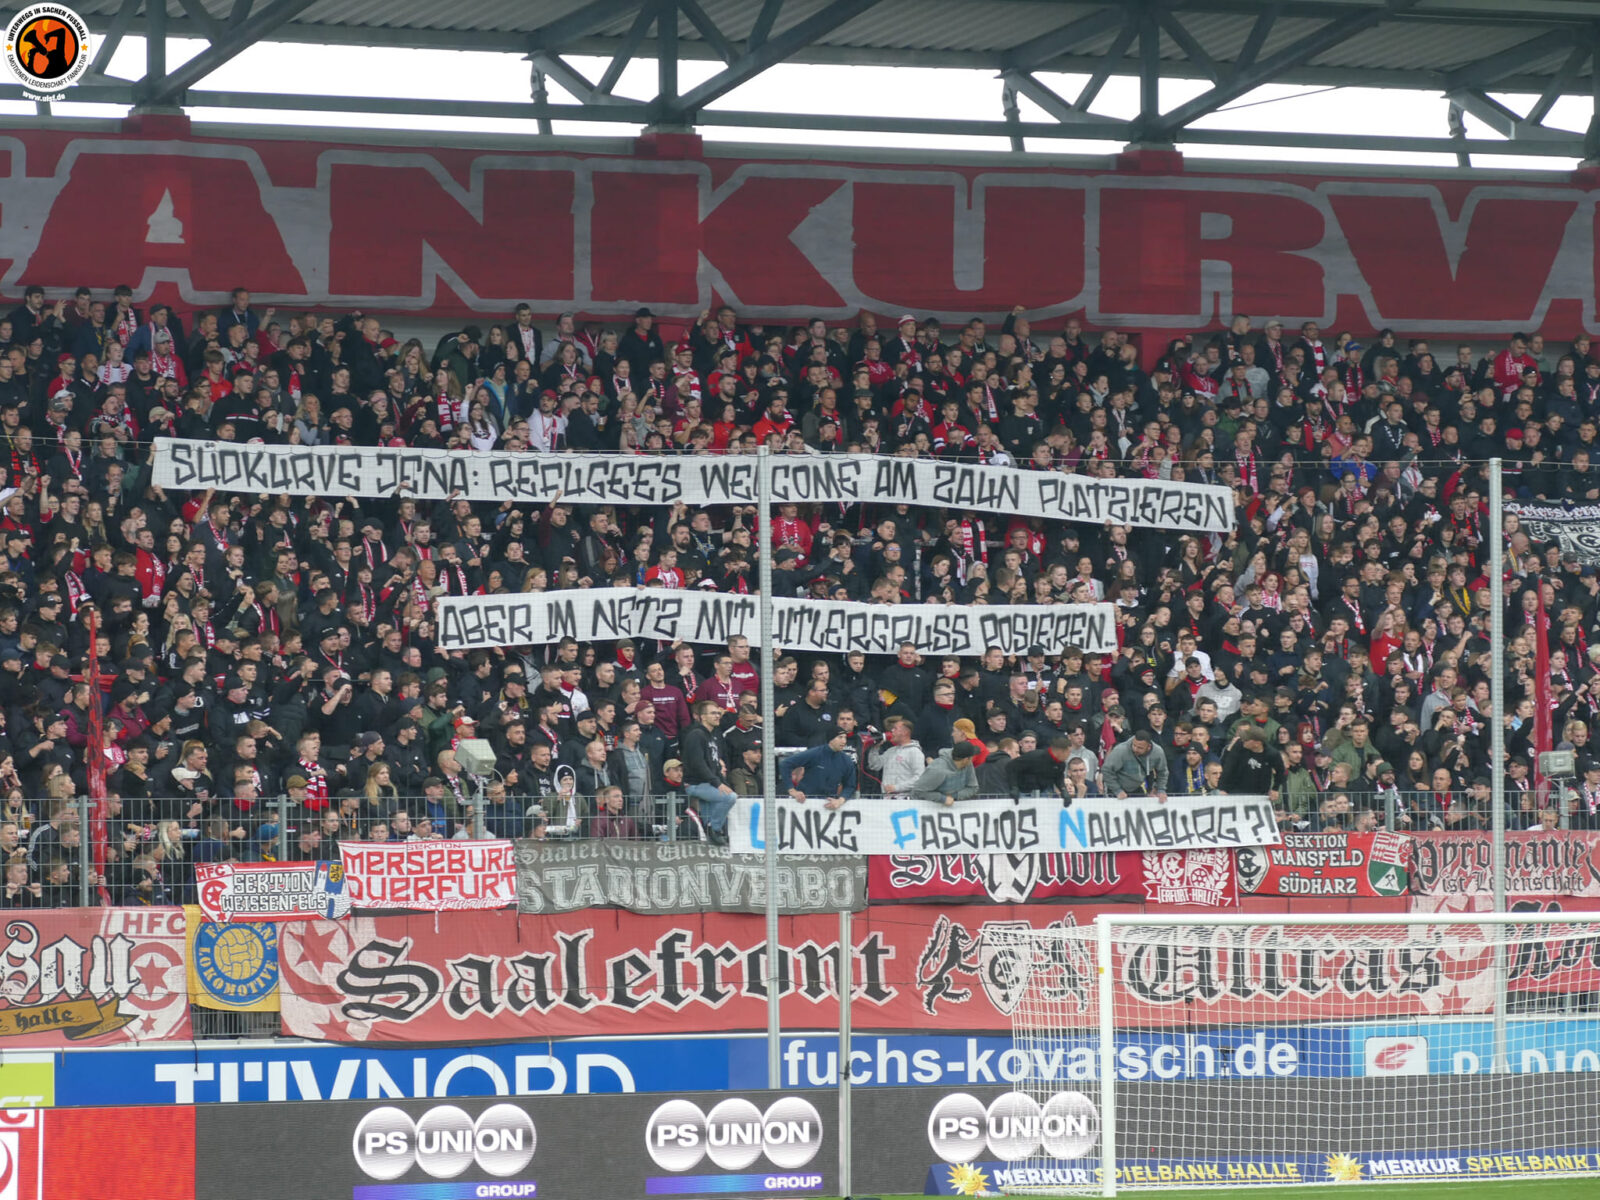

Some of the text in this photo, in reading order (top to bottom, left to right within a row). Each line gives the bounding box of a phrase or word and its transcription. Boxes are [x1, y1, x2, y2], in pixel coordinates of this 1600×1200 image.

[874, 460, 918, 500] AM
[441, 603, 533, 645] ABER
[408, 842, 462, 851] SEKTION
[1284, 833, 1348, 849] SEKTION
[1271, 849, 1366, 868] MANSFELD
[196, 866, 225, 880] HFC
[233, 871, 314, 894] SEKTION
[1278, 876, 1358, 895] SÜDHARZ
[221, 892, 327, 912] WEISSENFELS
[122, 912, 187, 935] HFC
[198, 946, 279, 997] LOKOMOTIVE
[334, 928, 900, 1022] Saalefront
[783, 1031, 1299, 1086] fuchs-kovasch.de
[656, 1120, 811, 1147] PS UNION
[938, 1113, 1088, 1140] PS UNION
[364, 1128, 525, 1155] PS UNION
[994, 1167, 1088, 1186] MERKUR
[1227, 1162, 1302, 1179] HALLE
[1368, 1154, 1590, 1176] MERKUR SPIELBANK
[475, 1183, 536, 1198] GROUP
[763, 1175, 823, 1190] GROUP
